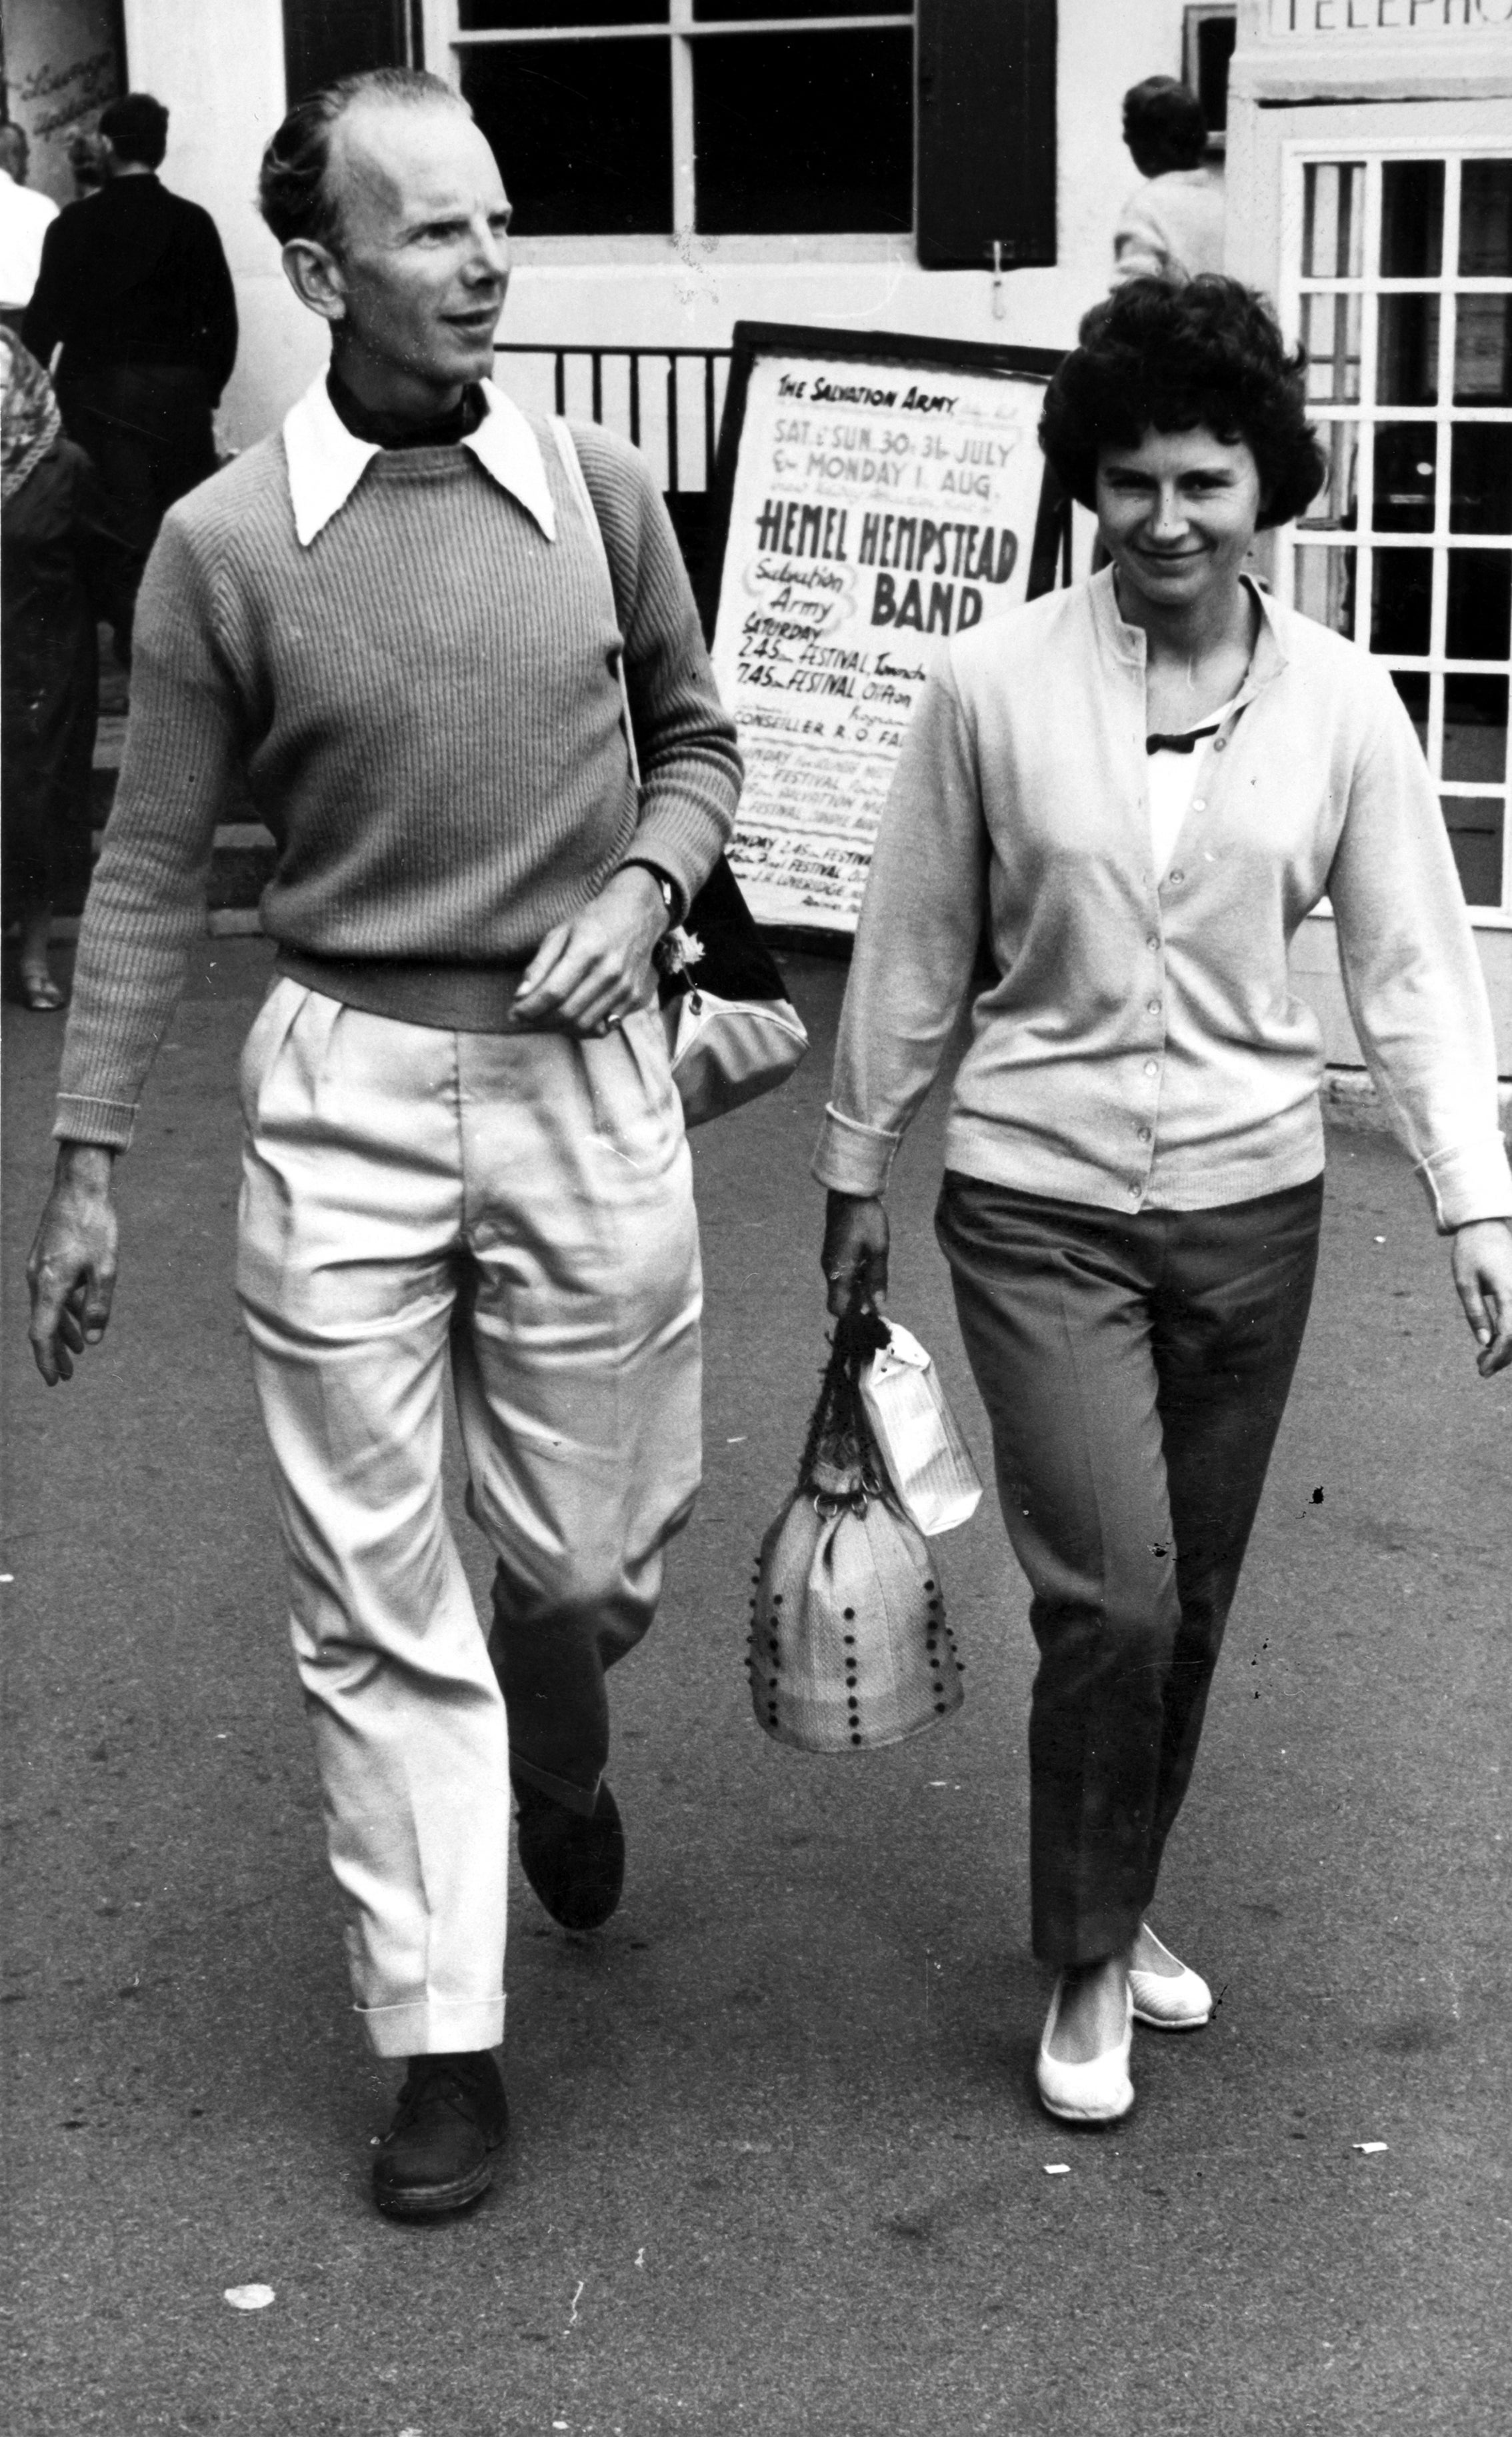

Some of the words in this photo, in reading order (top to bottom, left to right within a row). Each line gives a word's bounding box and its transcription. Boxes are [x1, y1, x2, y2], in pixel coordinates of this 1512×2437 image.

[777, 374, 807, 399] THE
[810, 376, 898, 407] SALVATION
[901, 385, 959, 413] ARMY
[806, 451, 907, 488] MONDAY
[955, 440, 1015, 467] JULY
[755, 499, 847, 562] HEMEL
[858, 511, 1019, 585] HEMPSTEAD
[770, 586, 833, 623] Army
[871, 571, 984, 637] BAND
